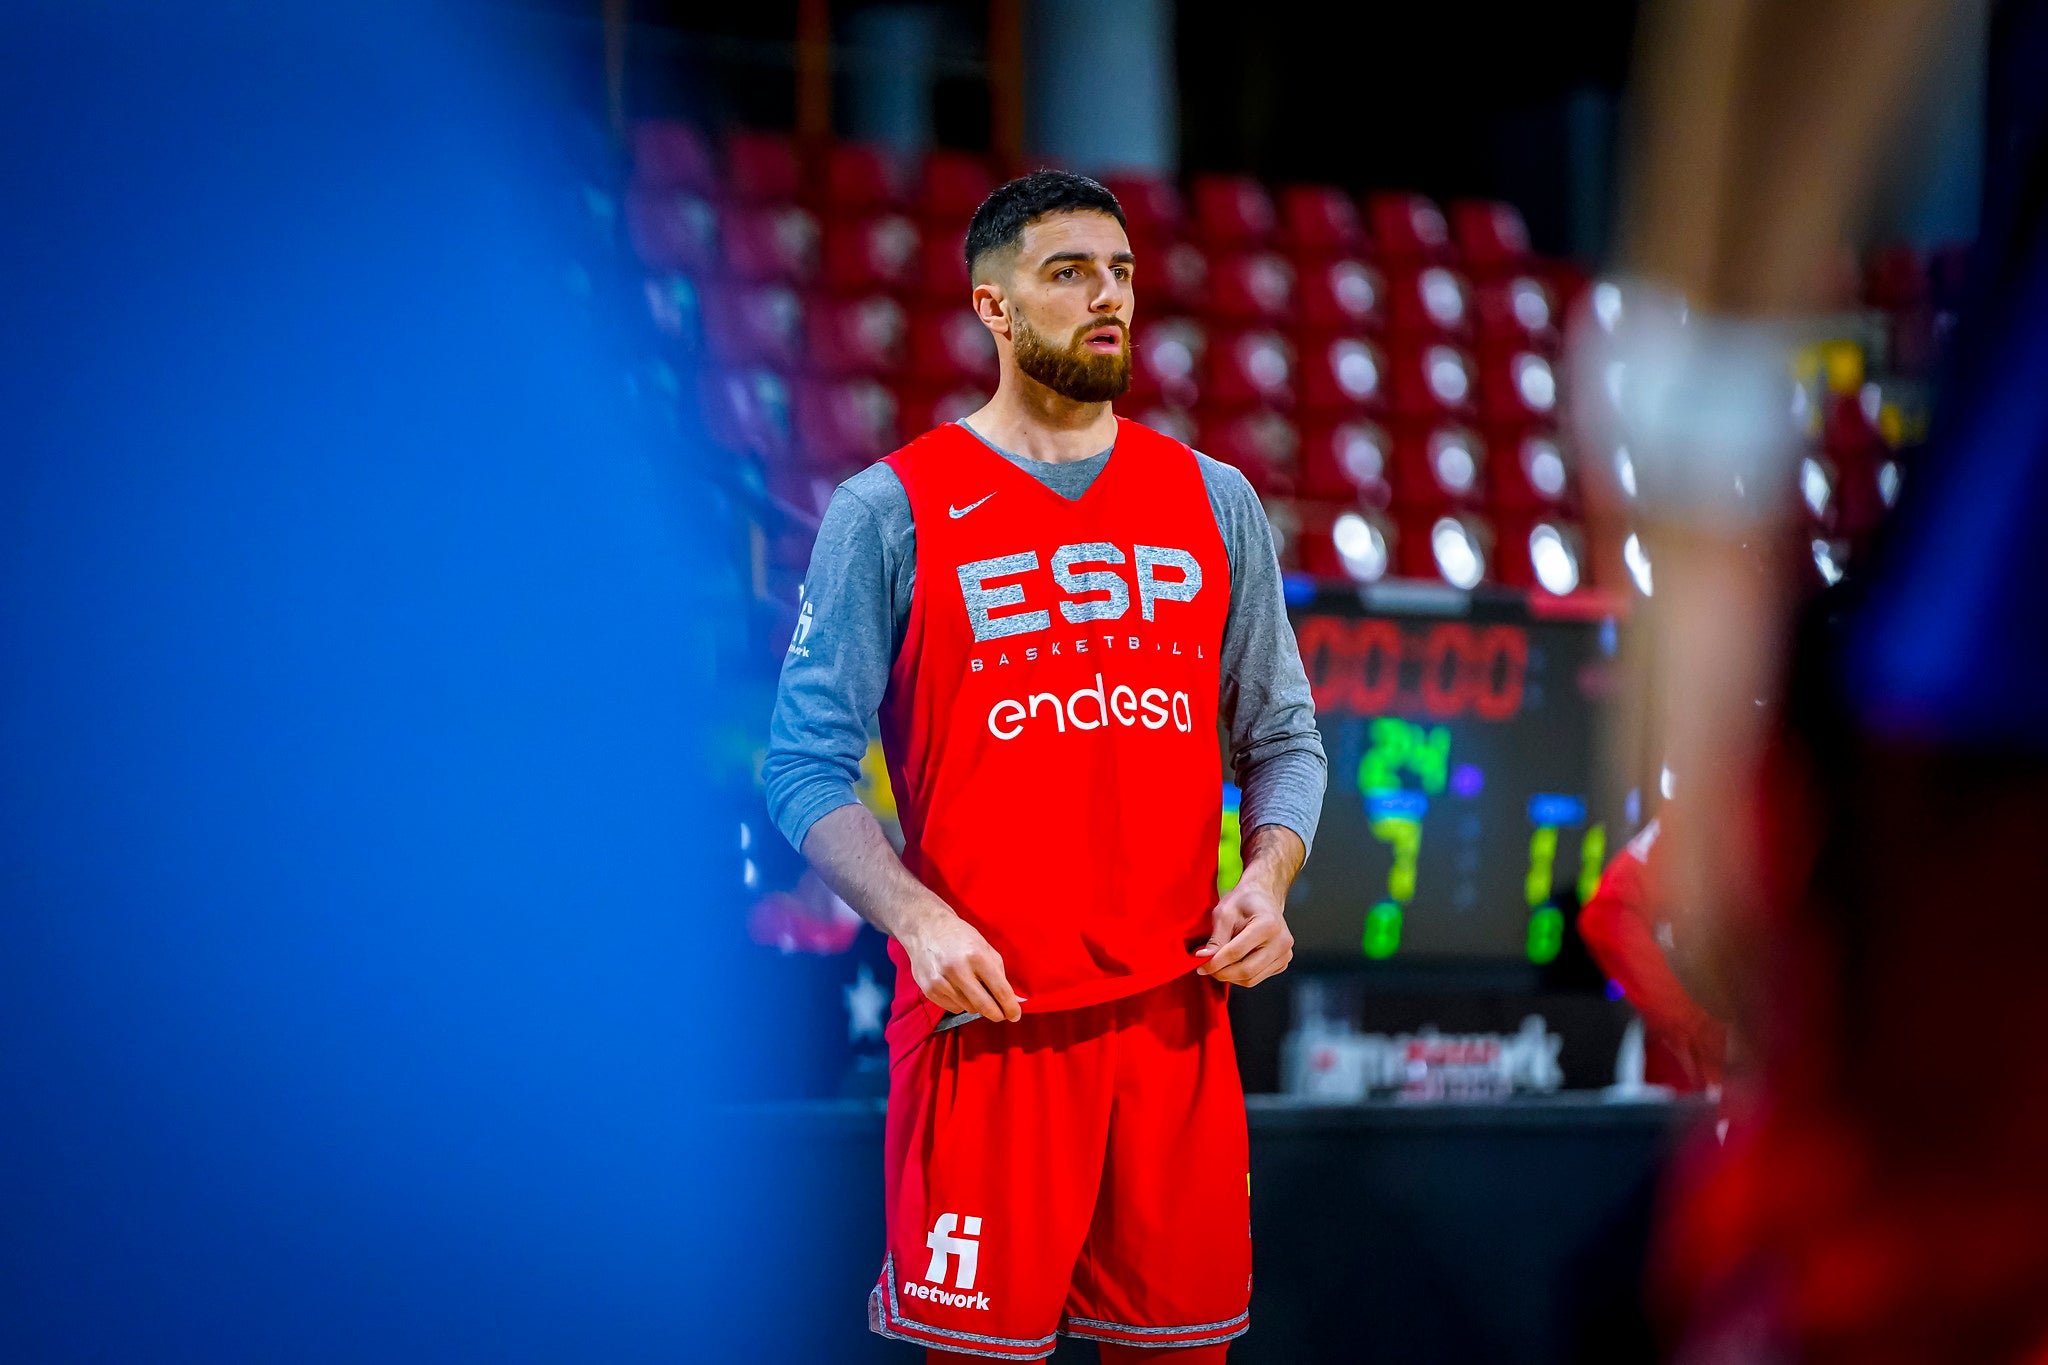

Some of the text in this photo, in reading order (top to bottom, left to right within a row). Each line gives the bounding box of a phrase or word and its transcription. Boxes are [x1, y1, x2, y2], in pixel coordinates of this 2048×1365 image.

[956, 542, 1203, 643] ESP
[988, 672, 1192, 741] endesa
[1358, 716, 1452, 796] 24
[904, 1280, 990, 1312] network
